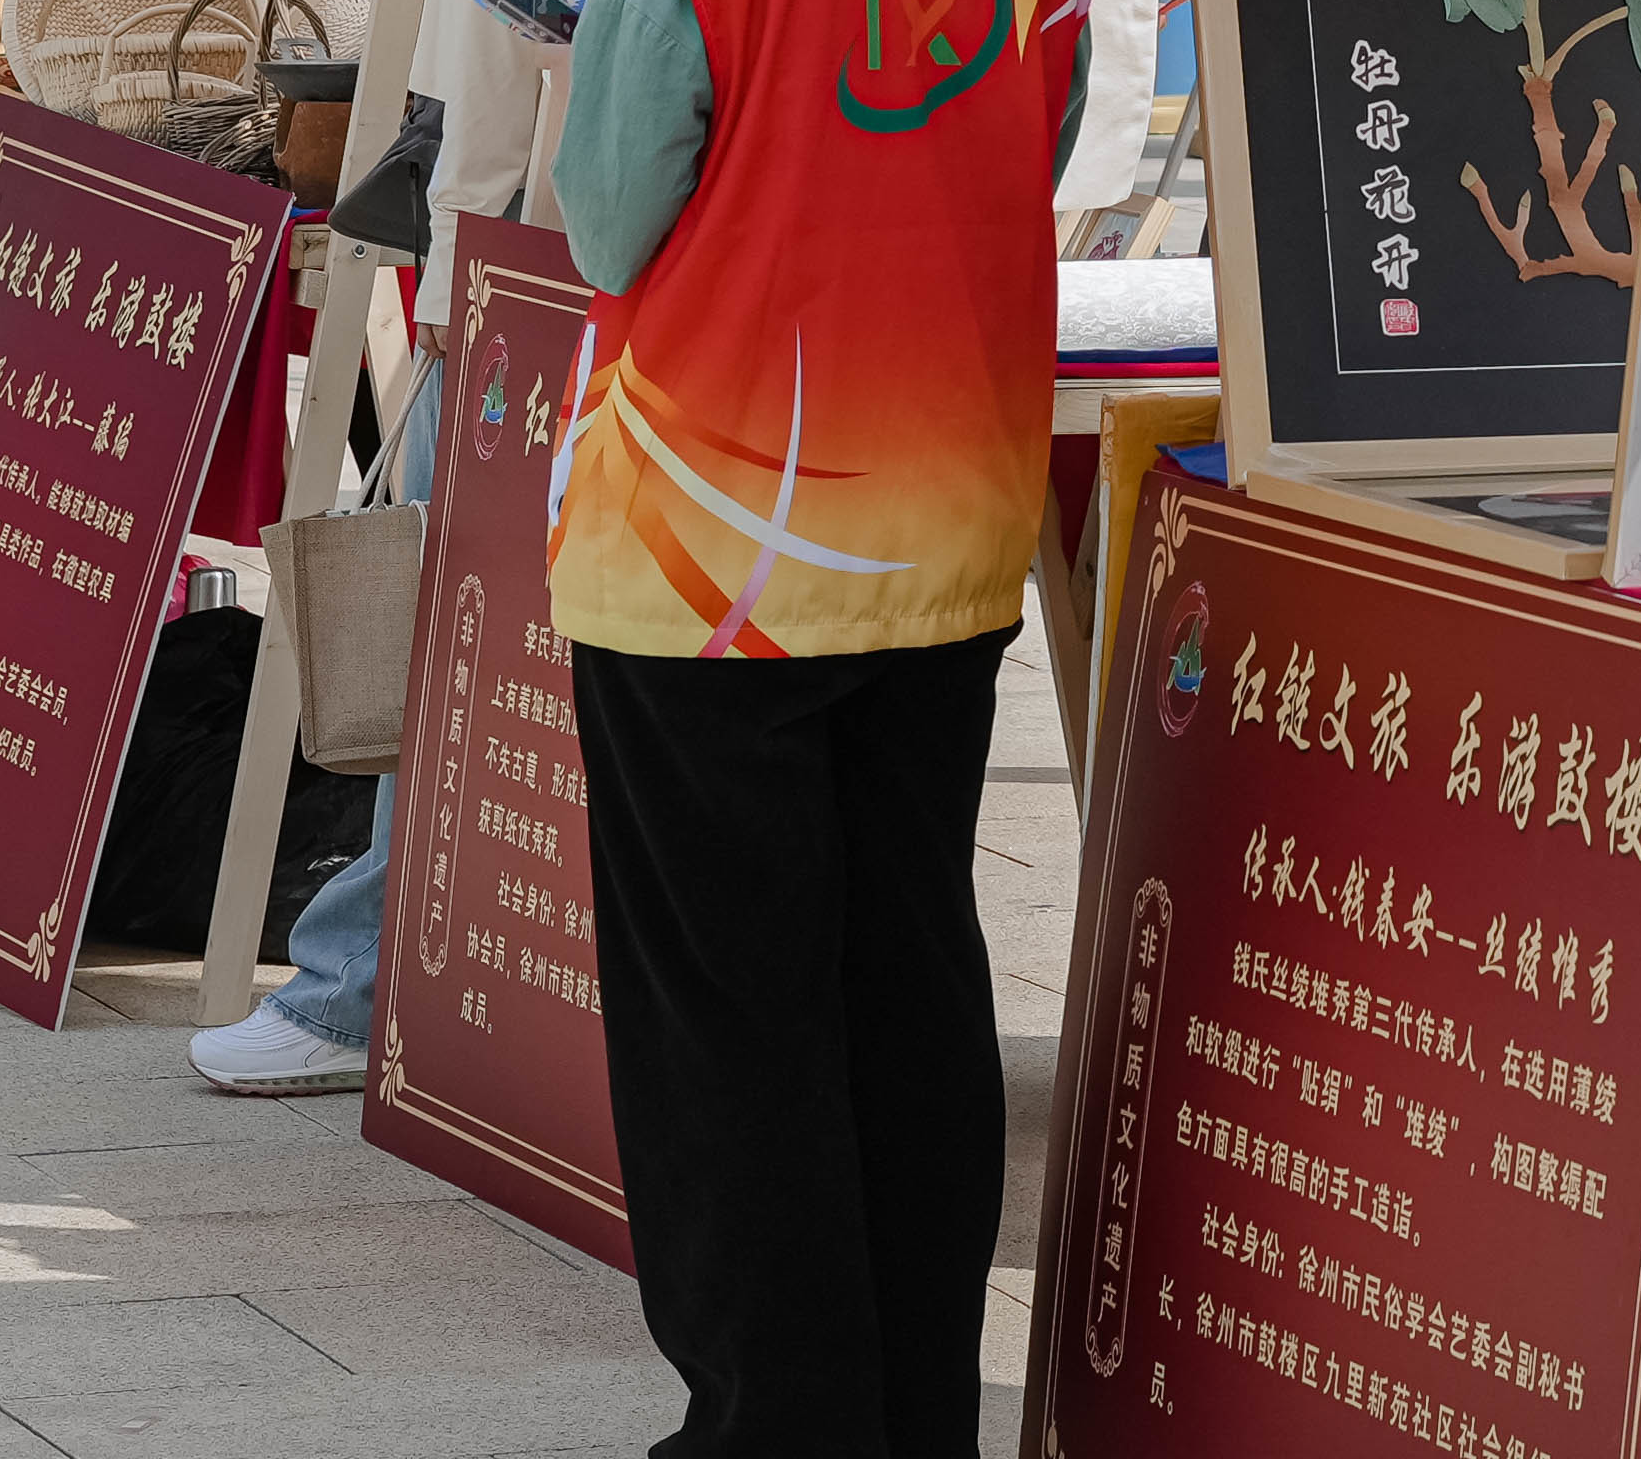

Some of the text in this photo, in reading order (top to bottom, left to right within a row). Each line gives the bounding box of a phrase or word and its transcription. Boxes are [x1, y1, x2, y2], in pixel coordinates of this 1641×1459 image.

[1351, 40, 1419, 290] 牡丹花开
[84, 260, 203, 370] 乐游鼓楼
[427, 611, 476, 934] 非物质文化遗产
[490, 674, 579, 736] 上有着独到功
[1230, 631, 1411, 782] 红链文旅
[460, 986, 492, 1035] 成员。
[1097, 923, 1159, 1323] 非物质文化遗产
[1175, 1099, 1422, 1248] 色方面具有很高的手工造诣。
